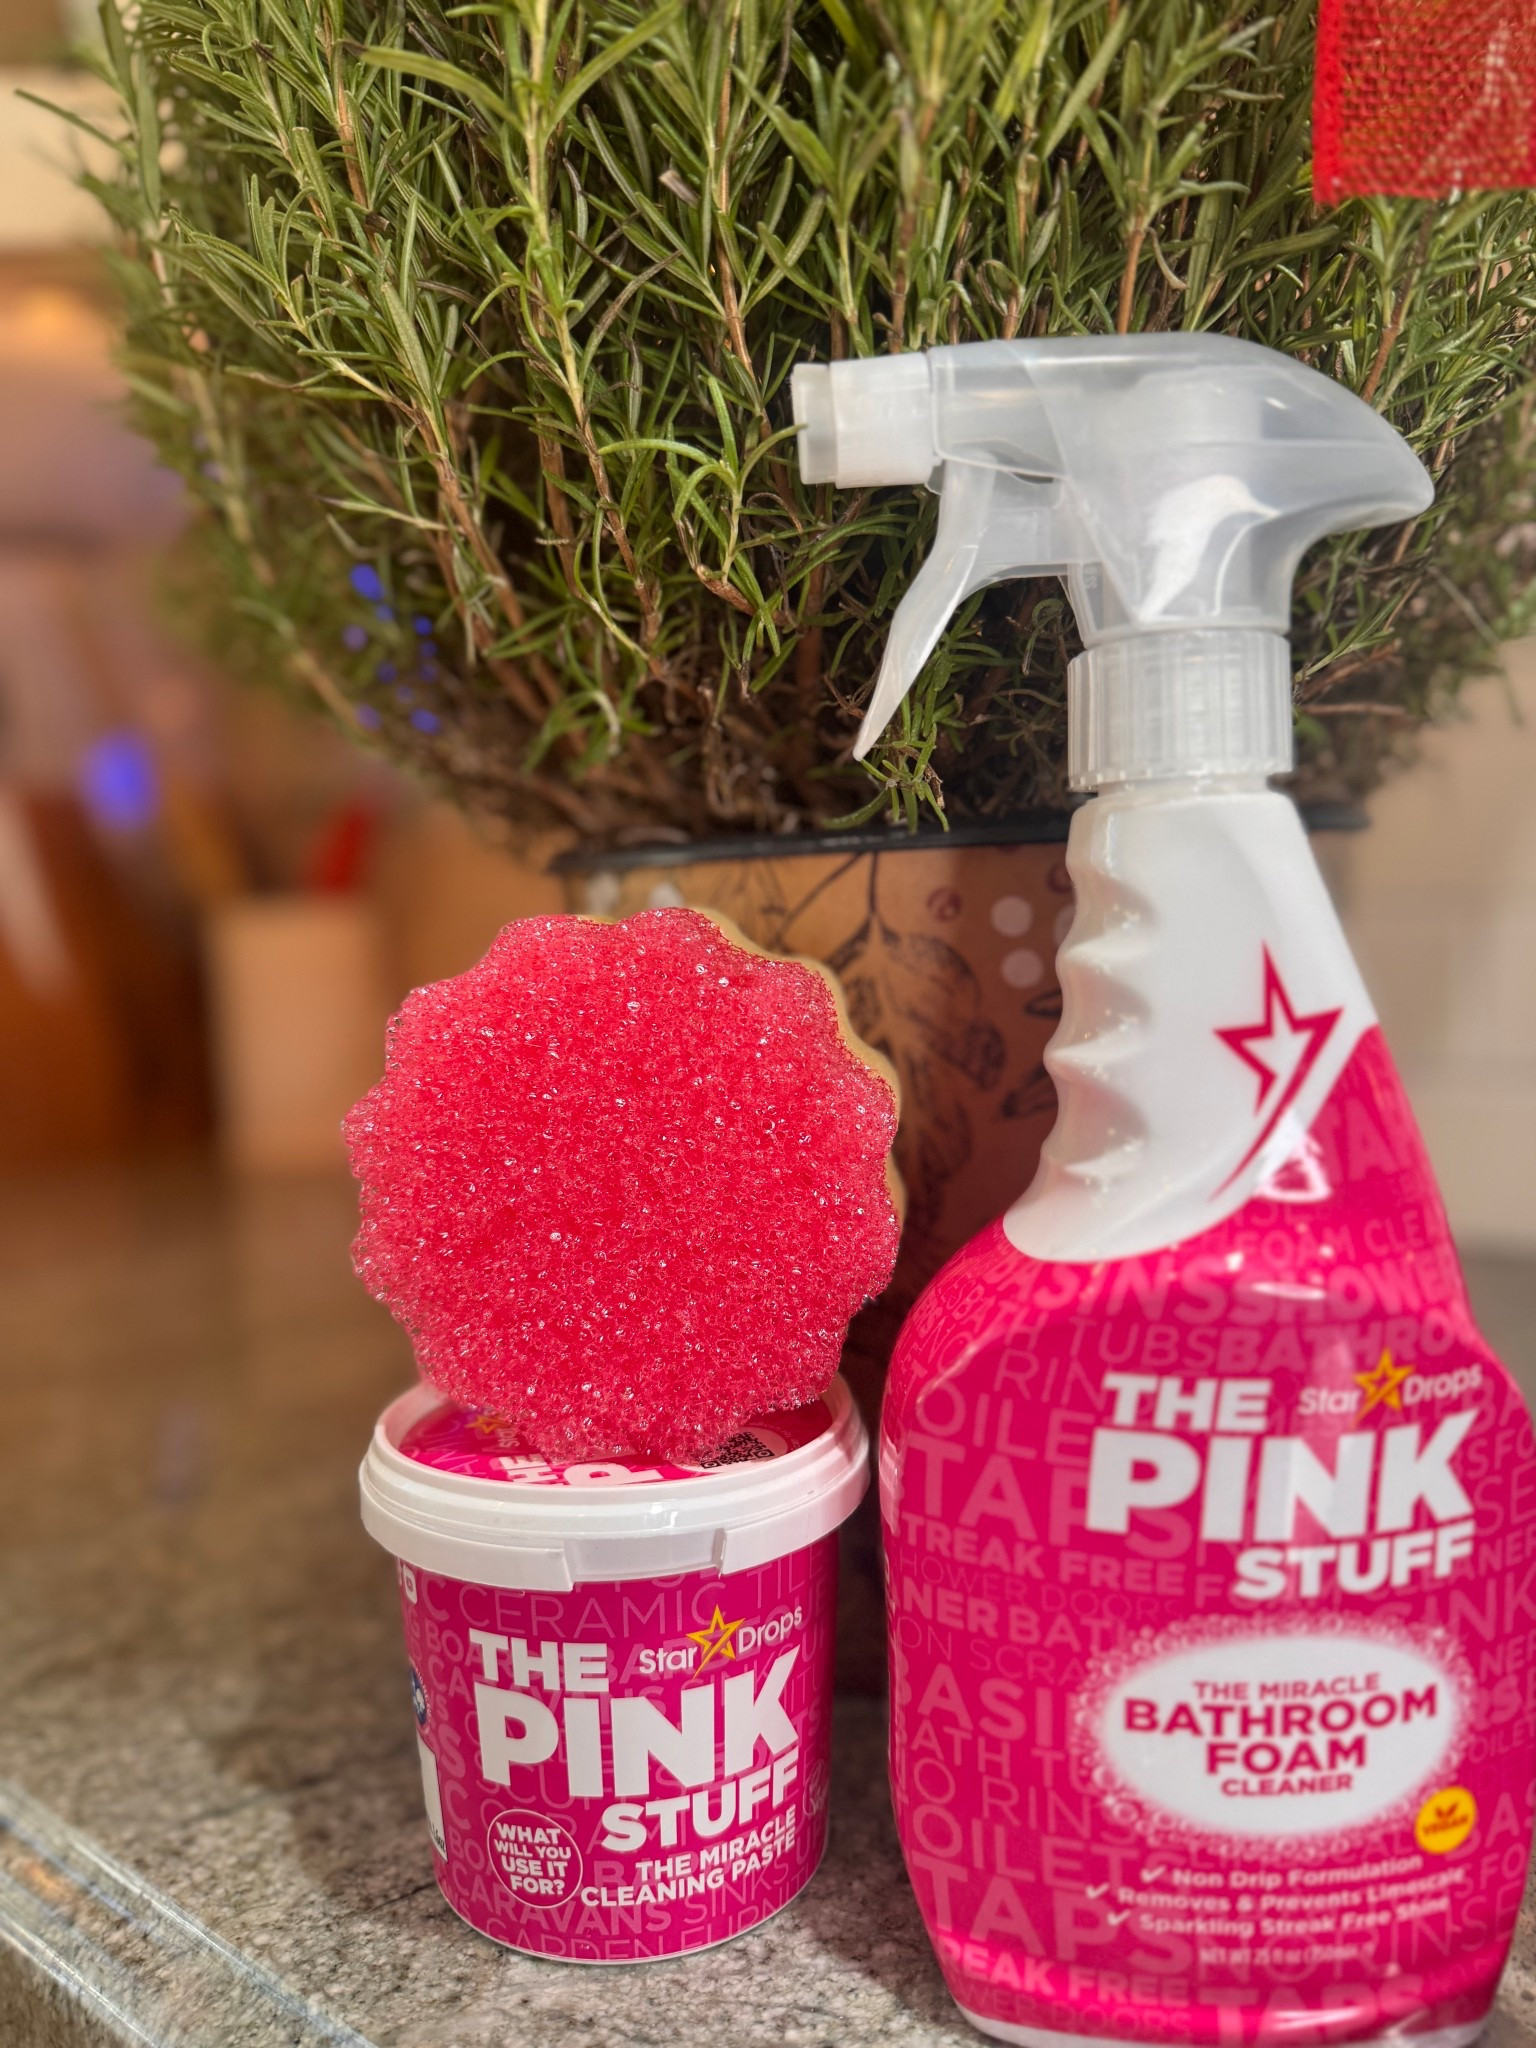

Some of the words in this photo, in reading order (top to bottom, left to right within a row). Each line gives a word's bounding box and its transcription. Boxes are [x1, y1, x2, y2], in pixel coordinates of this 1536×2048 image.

[1102, 1372, 1273, 1433] THE
[1298, 1385, 1362, 1416] Star
[1402, 1363, 1483, 1407] Drops
[1083, 1408, 1480, 1544] PINK
[1058, 1549, 1187, 1596] FREE
[1232, 1520, 1477, 1601] STUFF
[449, 1575, 725, 1642] CERAMIC
[468, 1627, 611, 1693] THE
[639, 1646, 699, 1675] Star
[737, 1604, 803, 1655] Drops
[1193, 1680, 1250, 1701] THE
[1257, 1671, 1383, 1701] MIRACLE
[472, 1643, 801, 1799] PINK
[1123, 1684, 1438, 1740] BATHROOM
[1206, 1735, 1368, 1776] FOAM
[600, 1744, 801, 1854] STUFF
[1220, 1773, 1355, 1797] CLEANER
[493, 1837, 533, 1859] WILL
[534, 1845, 572, 1860] YOU
[495, 1821, 561, 1846] WHAT
[635, 1852, 694, 1883] THE
[699, 1804, 797, 1870] MIRACLE
[500, 1854, 544, 1877] USE
[546, 1860, 569, 1878] IT
[509, 1873, 566, 1896] FOR?
[580, 1867, 726, 1908] CLEANING
[730, 1821, 797, 1883] PASTE
[1172, 1867, 1224, 1888] Non
[1228, 1869, 1283, 1892] Drip
[1287, 1854, 1424, 1887] Formulation
[1116, 1886, 1232, 1912] Removes
[1259, 1889, 1364, 1912] Prevents
[1138, 1912, 1255, 1939] Sparkling
[1067, 1963, 1191, 2006] FREE
